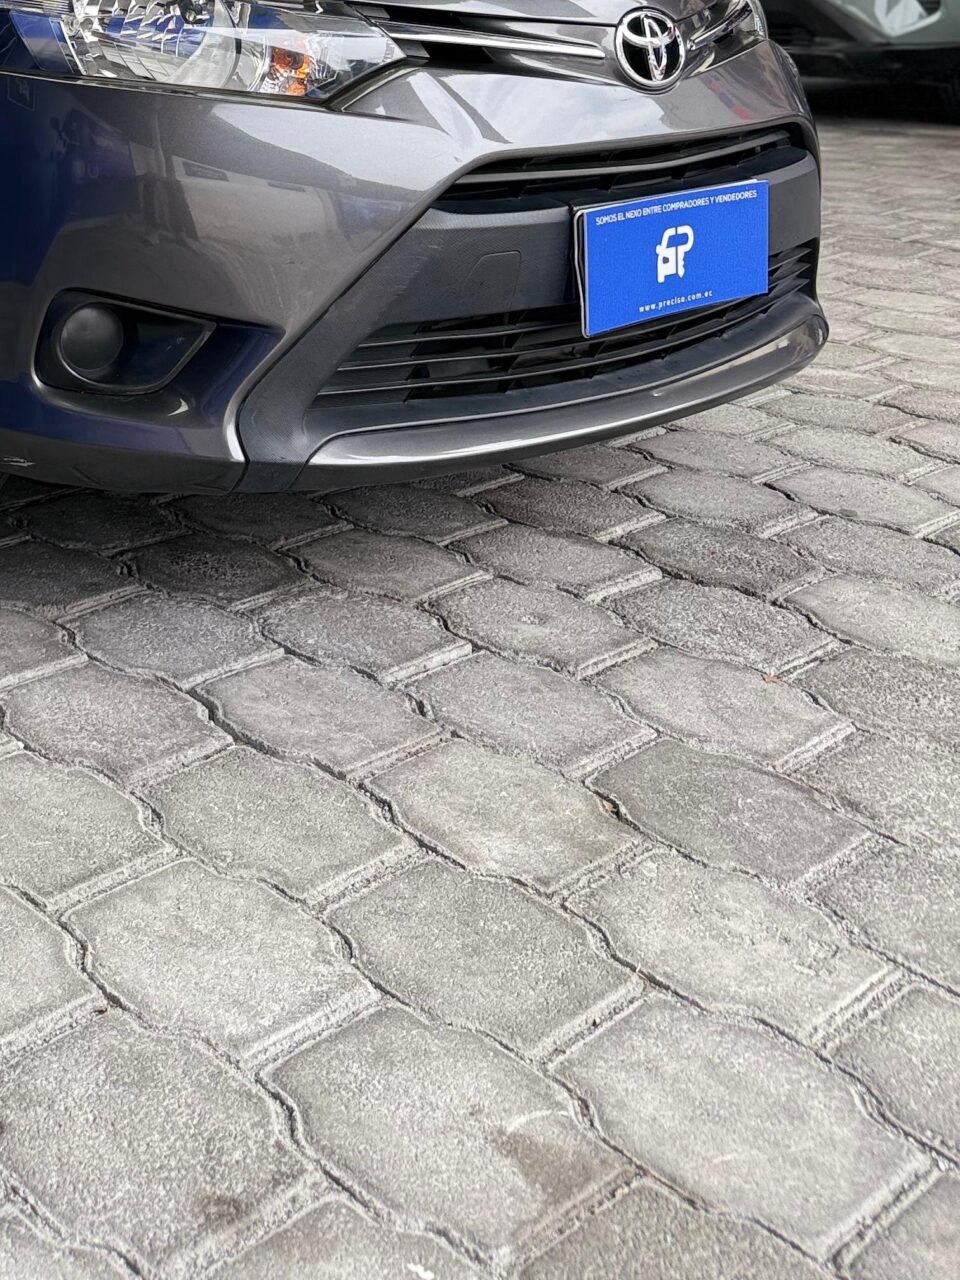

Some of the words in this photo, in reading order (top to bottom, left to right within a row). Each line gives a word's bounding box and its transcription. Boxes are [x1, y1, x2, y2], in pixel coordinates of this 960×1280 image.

[595, 214, 617, 226] SOMOS
[617, 212, 626, 222] EL
[625, 209, 642, 220] NEXO
[642, 205, 662, 217] ENTRE
[662, 197, 709, 213] COMPRADORES
[709, 196, 715, 204] Y
[714, 189, 758, 204] VENDEDORES
